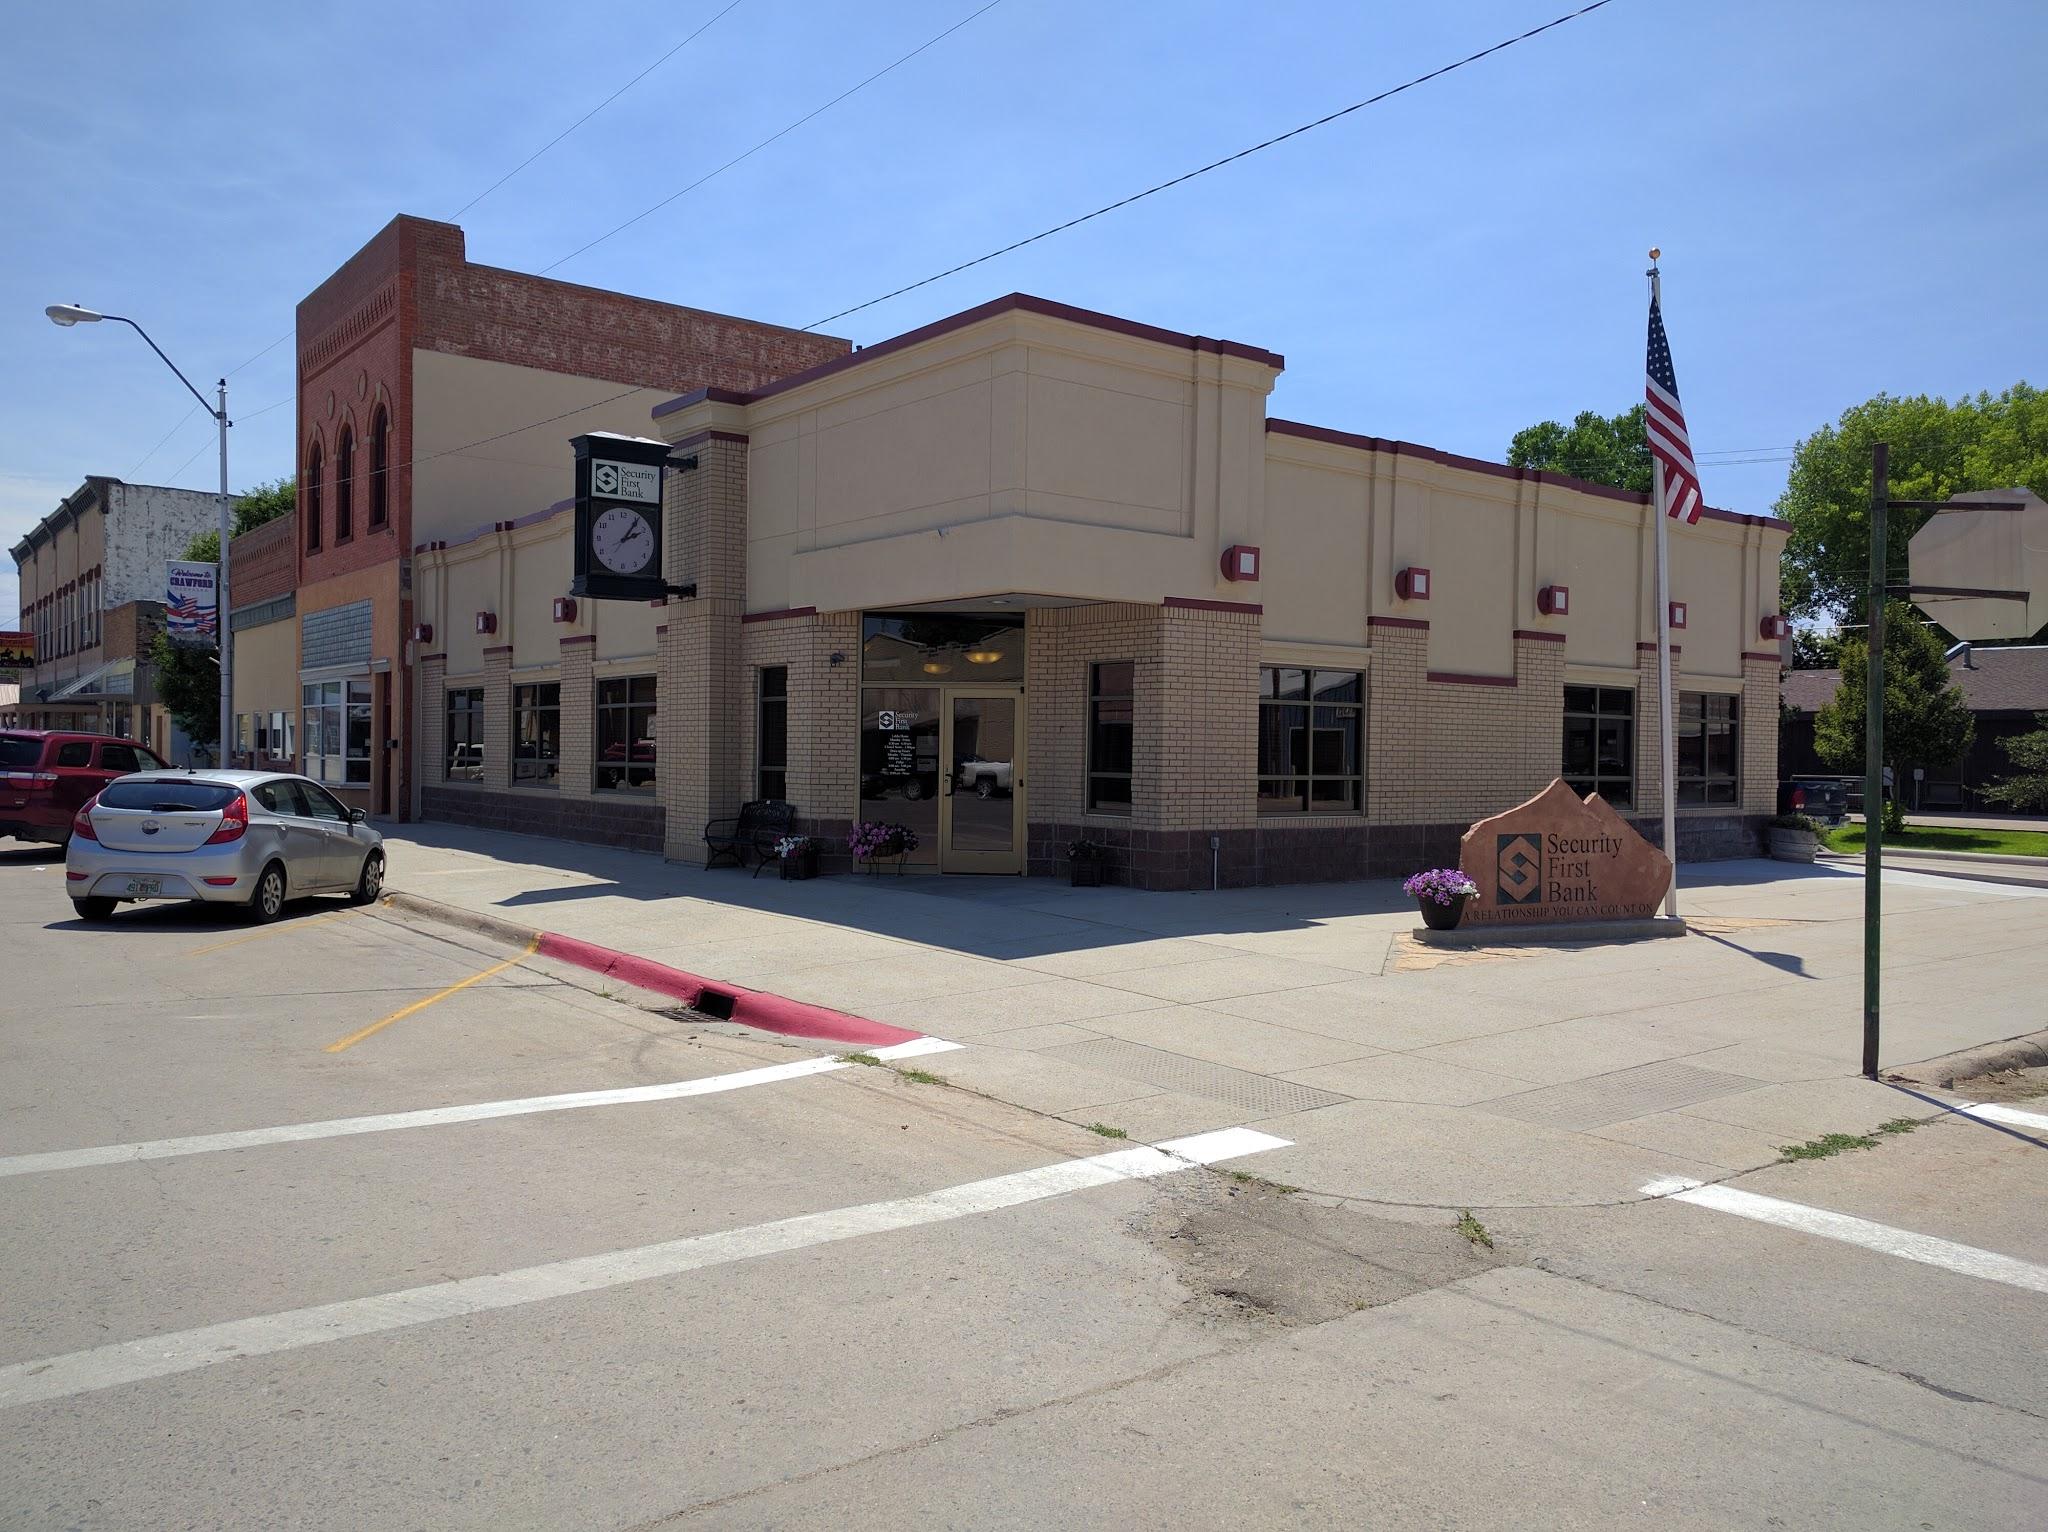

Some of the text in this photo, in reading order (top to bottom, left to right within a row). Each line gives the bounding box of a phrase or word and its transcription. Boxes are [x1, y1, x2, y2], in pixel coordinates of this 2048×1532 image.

[621, 467, 656, 483] Security
[621, 477, 641, 488] First
[621, 487, 643, 499] Bank
[171, 568, 204, 578] Welcome
[170, 576, 214, 589] CRAWFORD
[895, 711, 919, 720] Security
[1547, 832, 1623, 858] Security
[1548, 856, 1590, 879] First
[1548, 879, 1599, 902] Bank
[1464, 903, 1653, 921] A RELATIONSHIP YOU CAN COUNT ON
